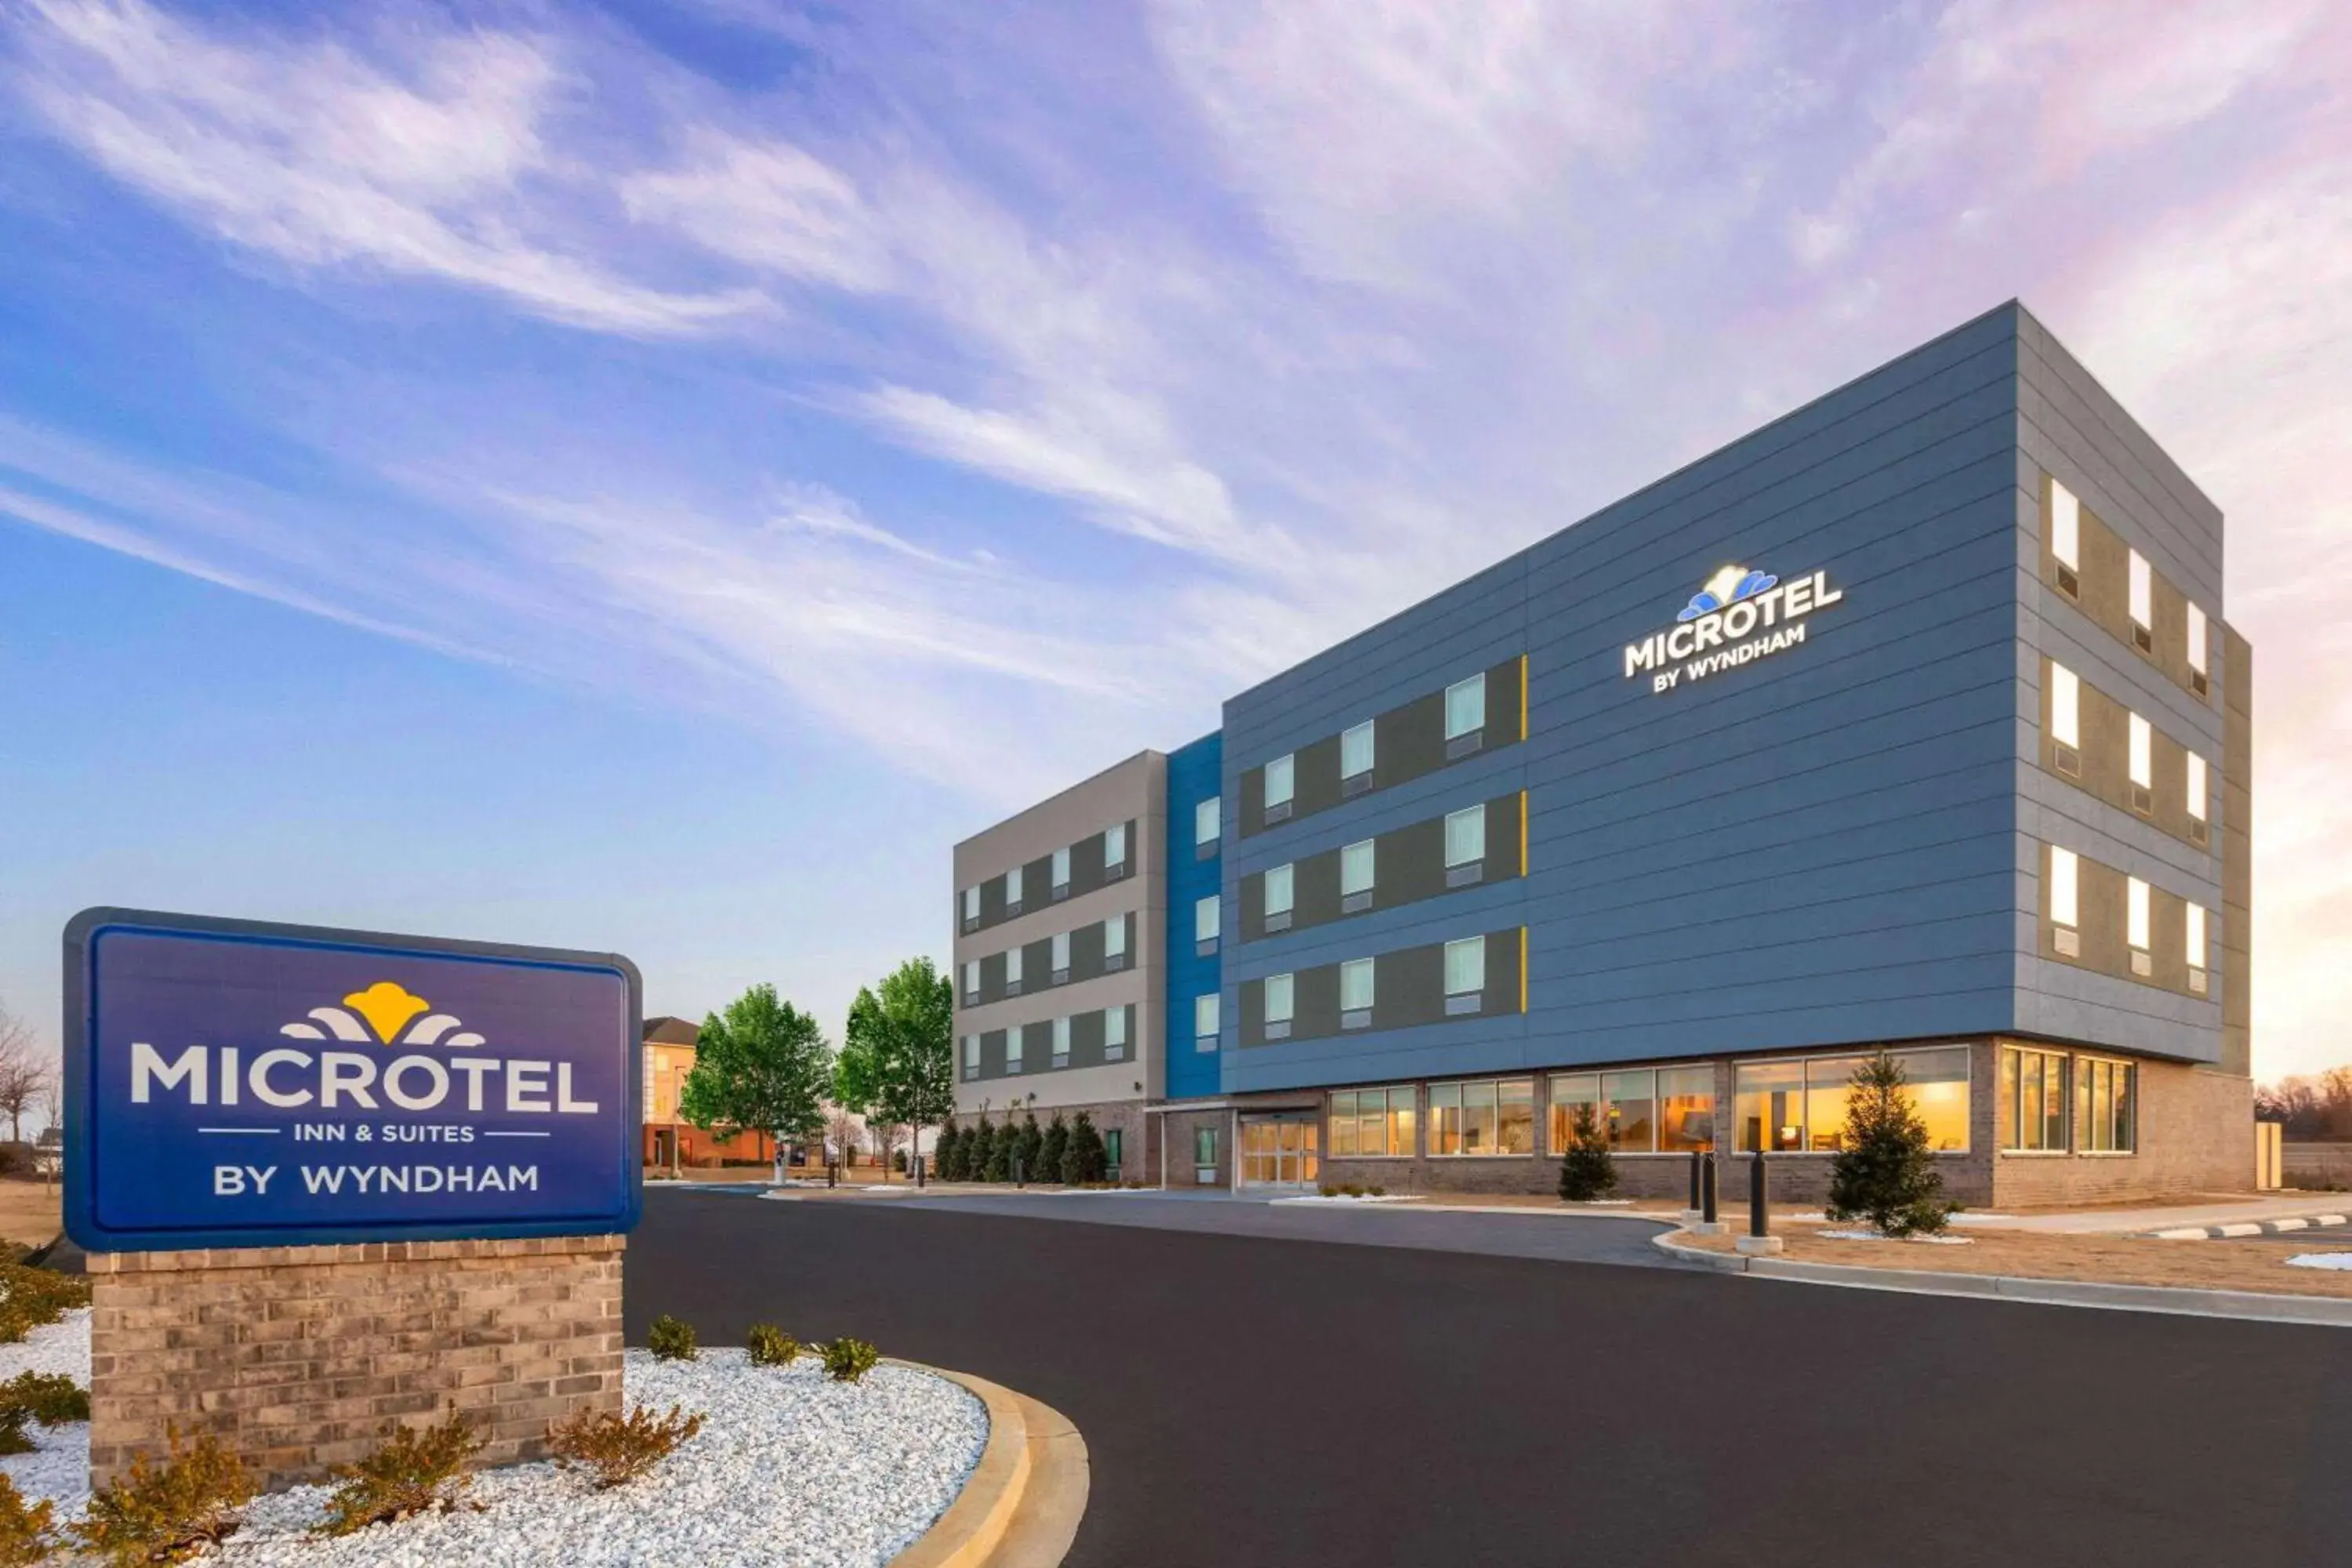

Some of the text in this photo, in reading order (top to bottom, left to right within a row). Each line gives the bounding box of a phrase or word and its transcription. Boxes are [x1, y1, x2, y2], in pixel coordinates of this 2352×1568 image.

[1624, 570, 1842, 677] MICROTEL
[1653, 624, 1806, 693] BY WYNDHAM
[130, 1043, 598, 1114] MICROTEL
[294, 1123, 475, 1143] INN & SUITES
[214, 1165, 539, 1195] BY WYNDHAM
